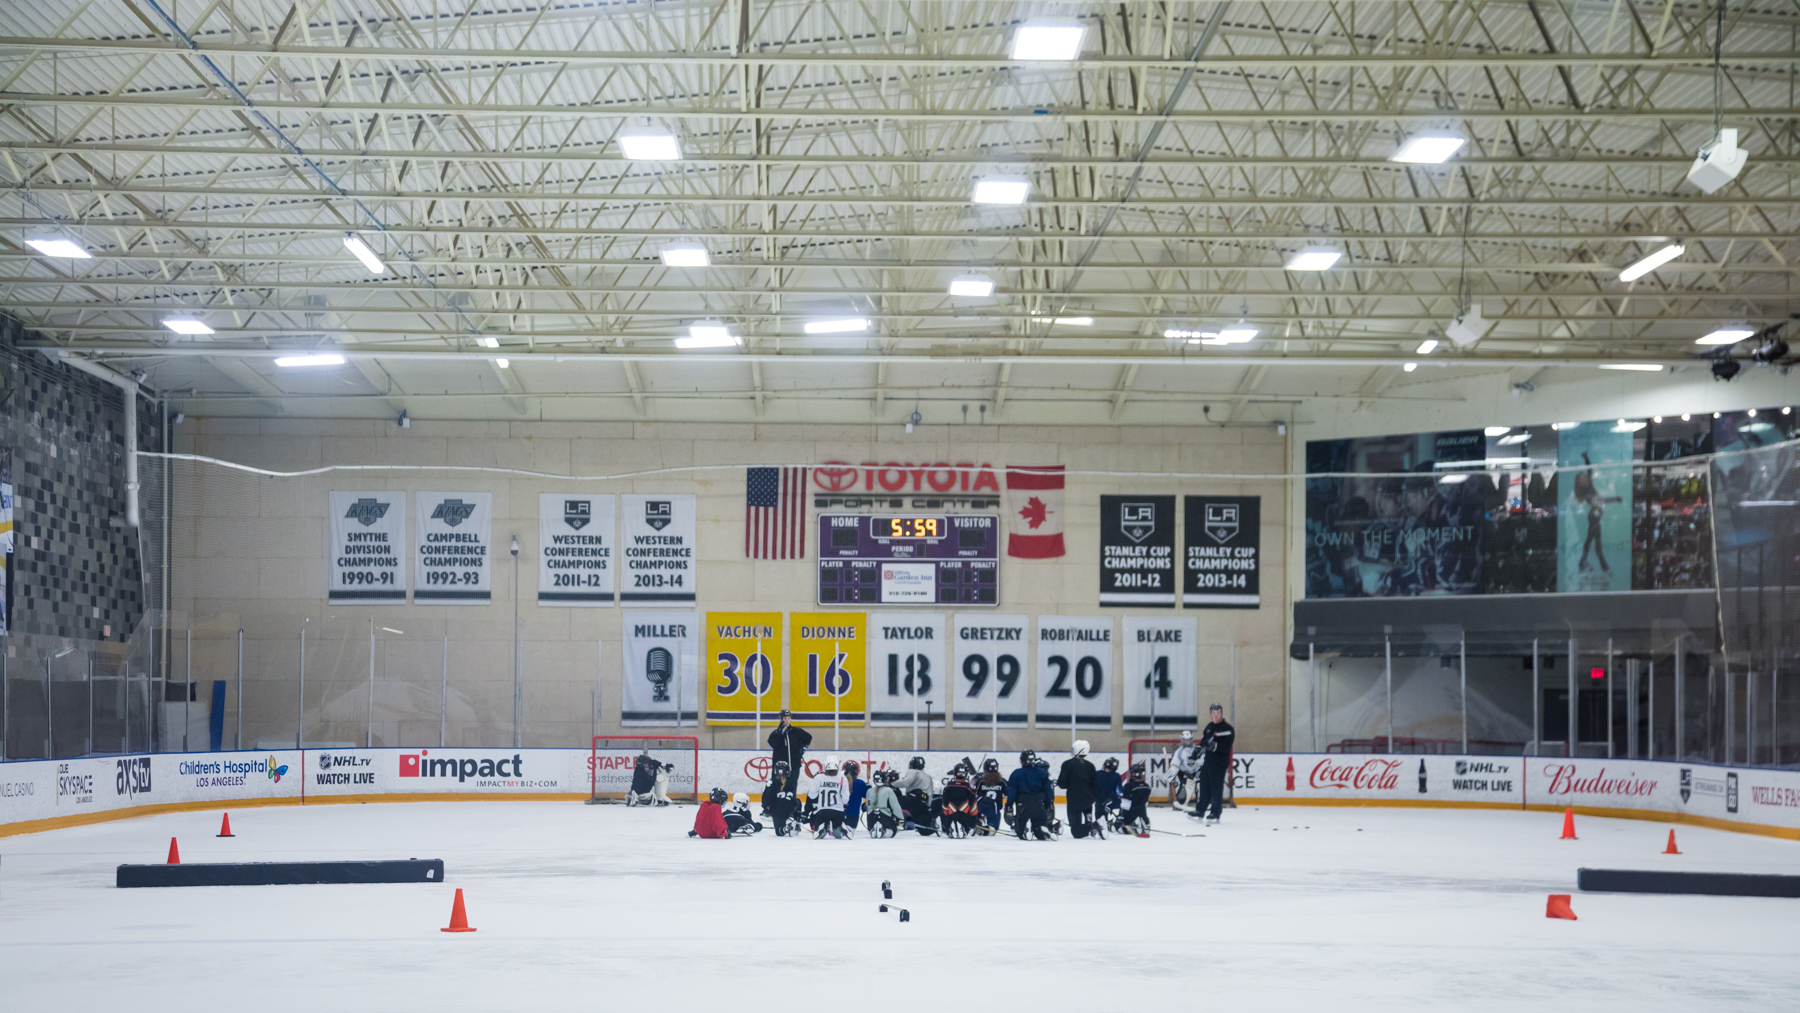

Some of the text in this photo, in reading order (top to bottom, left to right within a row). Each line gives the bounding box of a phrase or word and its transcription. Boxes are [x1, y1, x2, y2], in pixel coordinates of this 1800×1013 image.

[860, 462, 1000, 492] TOYOTA
[566, 502, 589, 513] LA
[647, 504, 670, 514] LA
[814, 498, 1000, 508] SPORTS CENTER
[1124, 507, 1152, 520] LA
[1208, 508, 1236, 520] LA
[831, 517, 860, 528] HOME
[891, 518, 937, 537] 5:59
[954, 518, 992, 528] VISITOR
[347, 532, 388, 542] SMYTHE
[426, 533, 480, 543] CAMPBELL
[552, 535, 602, 544] WESTERN
[634, 536, 683, 545] WESTERN
[1315, 526, 1475, 547] OWN THE MOMENT
[344, 545, 391, 555] DIVISION
[420, 546, 486, 555] CONFERENCE
[544, 547, 610, 557] CONFERENCE
[626, 548, 691, 558] CONFERENCE
[1104, 546, 1171, 556] STANLEY CUP
[1188, 546, 1255, 558] STANLEY CUP
[337, 557, 398, 567] CHAMPIONS
[423, 557, 483, 567] CHAMPIONS
[547, 560, 606, 570] CHAMPIONS
[629, 560, 688, 570] CHAMPIONS
[1104, 558, 1171, 569] CHAMPIONS
[1188, 558, 1255, 570] CHAMPIONS
[342, 572, 394, 585] 1990-91
[426, 572, 480, 585] 1992-93
[554, 574, 600, 586] 2011-12
[634, 574, 683, 587] 2013-14
[1114, 573, 1161, 587] 2011-12
[1197, 574, 1246, 588] 2013-14
[634, 624, 686, 638] MILLER
[801, 626, 856, 640] DIONNE
[882, 626, 934, 640] TAYLOR
[960, 627, 1022, 640] GRETZKY
[1041, 628, 1110, 642] ROBITAILLE
[1137, 630, 1182, 642] BLAKE
[716, 652, 773, 697] 30
[807, 652, 852, 697] 16
[888, 653, 932, 697] 18
[962, 654, 1021, 698] 99
[1045, 654, 1104, 700] 20
[1144, 656, 1172, 700] 4
[180, 758, 268, 778] Children's Hospital
[422, 750, 522, 782] impact
[587, 756, 652, 770] STAPL
[316, 773, 374, 785] WATCH LIVE
[1310, 758, 1404, 790] Coca-Cola
[1544, 764, 1658, 796] Budweiser
[60, 774, 92, 796] SKYSPACE
[196, 776, 244, 787] LOS ANGELES
[1453, 779, 1513, 792] WATCH LIVE
[14, 782, 34, 796] CASINO
[820, 790, 837, 807] 10
[1752, 786, 1800, 808] WELLS FA
